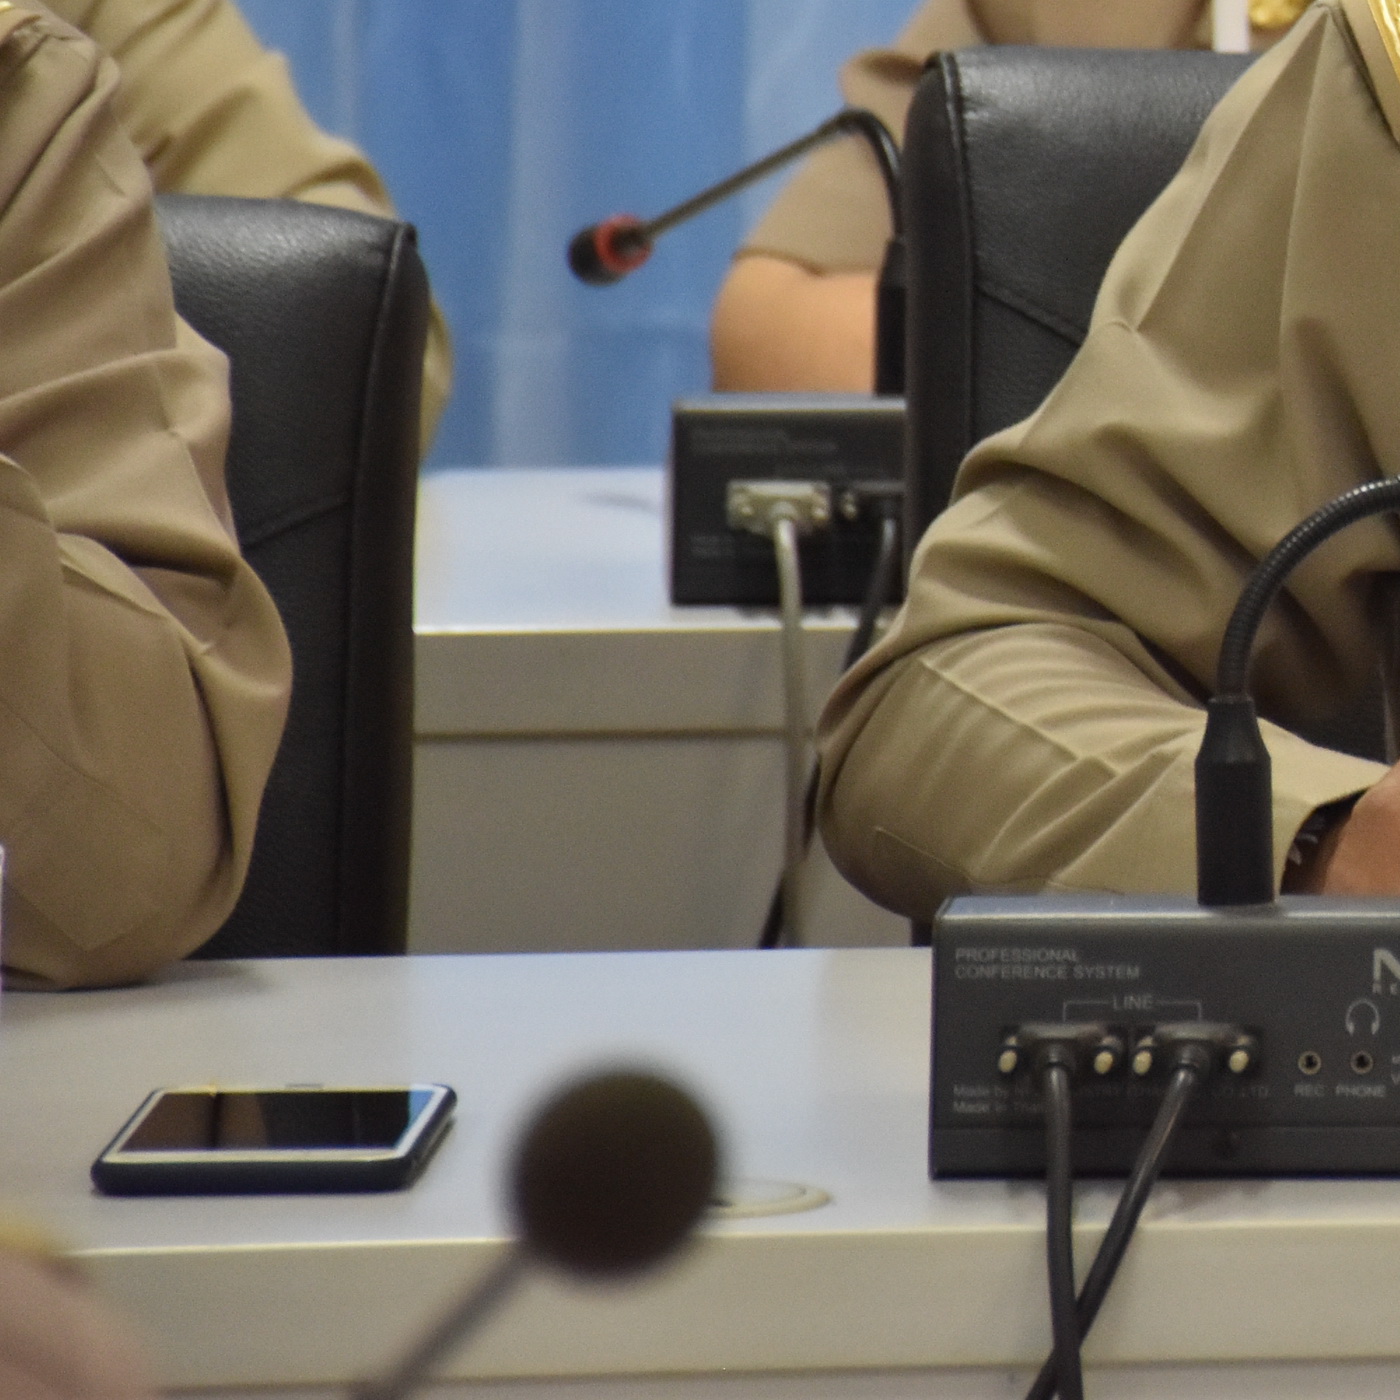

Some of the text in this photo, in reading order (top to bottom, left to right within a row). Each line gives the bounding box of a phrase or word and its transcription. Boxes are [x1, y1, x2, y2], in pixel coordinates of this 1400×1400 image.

[955, 947, 1078, 963] PROFESSIONAL
[955, 965, 1140, 980] CONFERENCE SYSTEM
[1113, 994, 1154, 1011] LINE
[1335, 1083, 1387, 1098] PHONE
